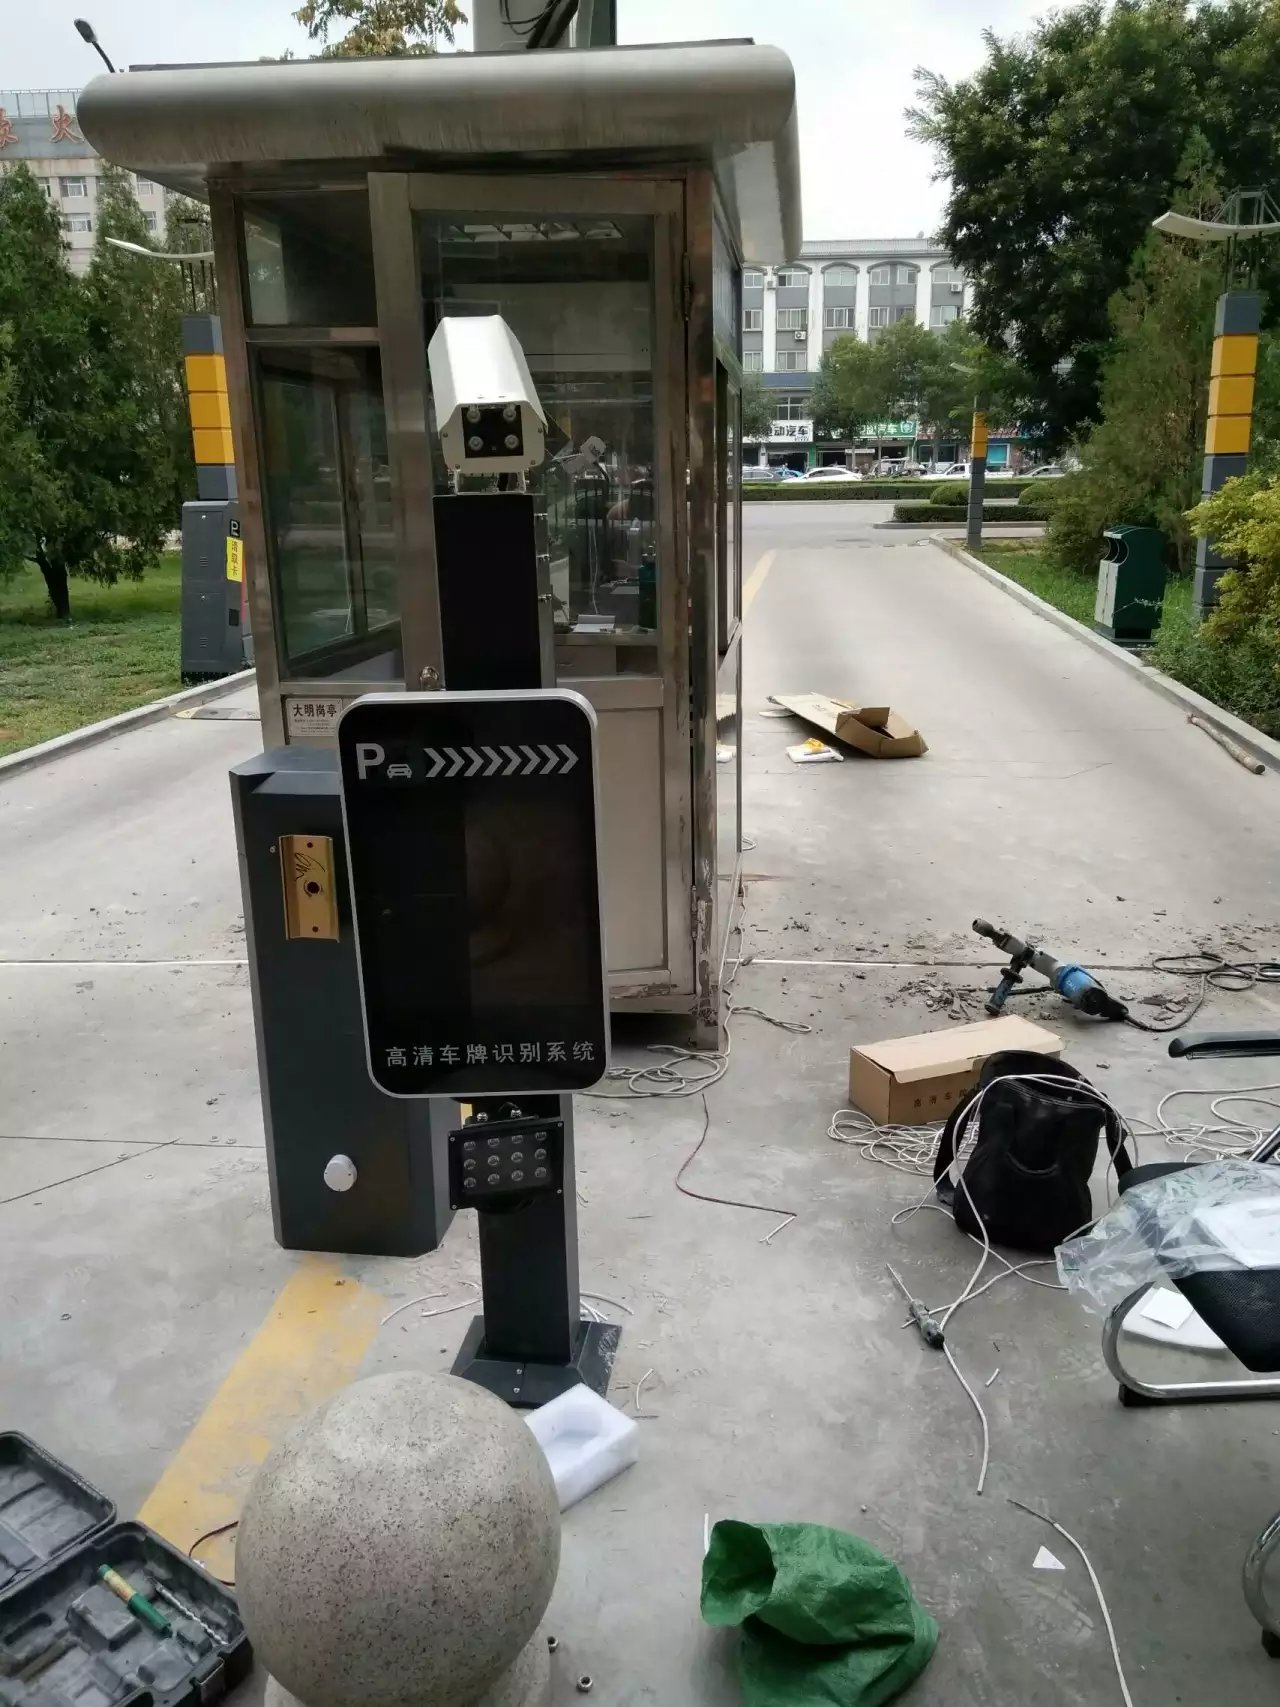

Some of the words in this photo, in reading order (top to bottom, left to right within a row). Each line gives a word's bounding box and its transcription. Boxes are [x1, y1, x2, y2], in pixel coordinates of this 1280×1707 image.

[292, 703, 337, 718] 大明岗亭
[356, 743, 385, 779] P
[385, 1041, 595, 1067] 高清车牌识别系统
